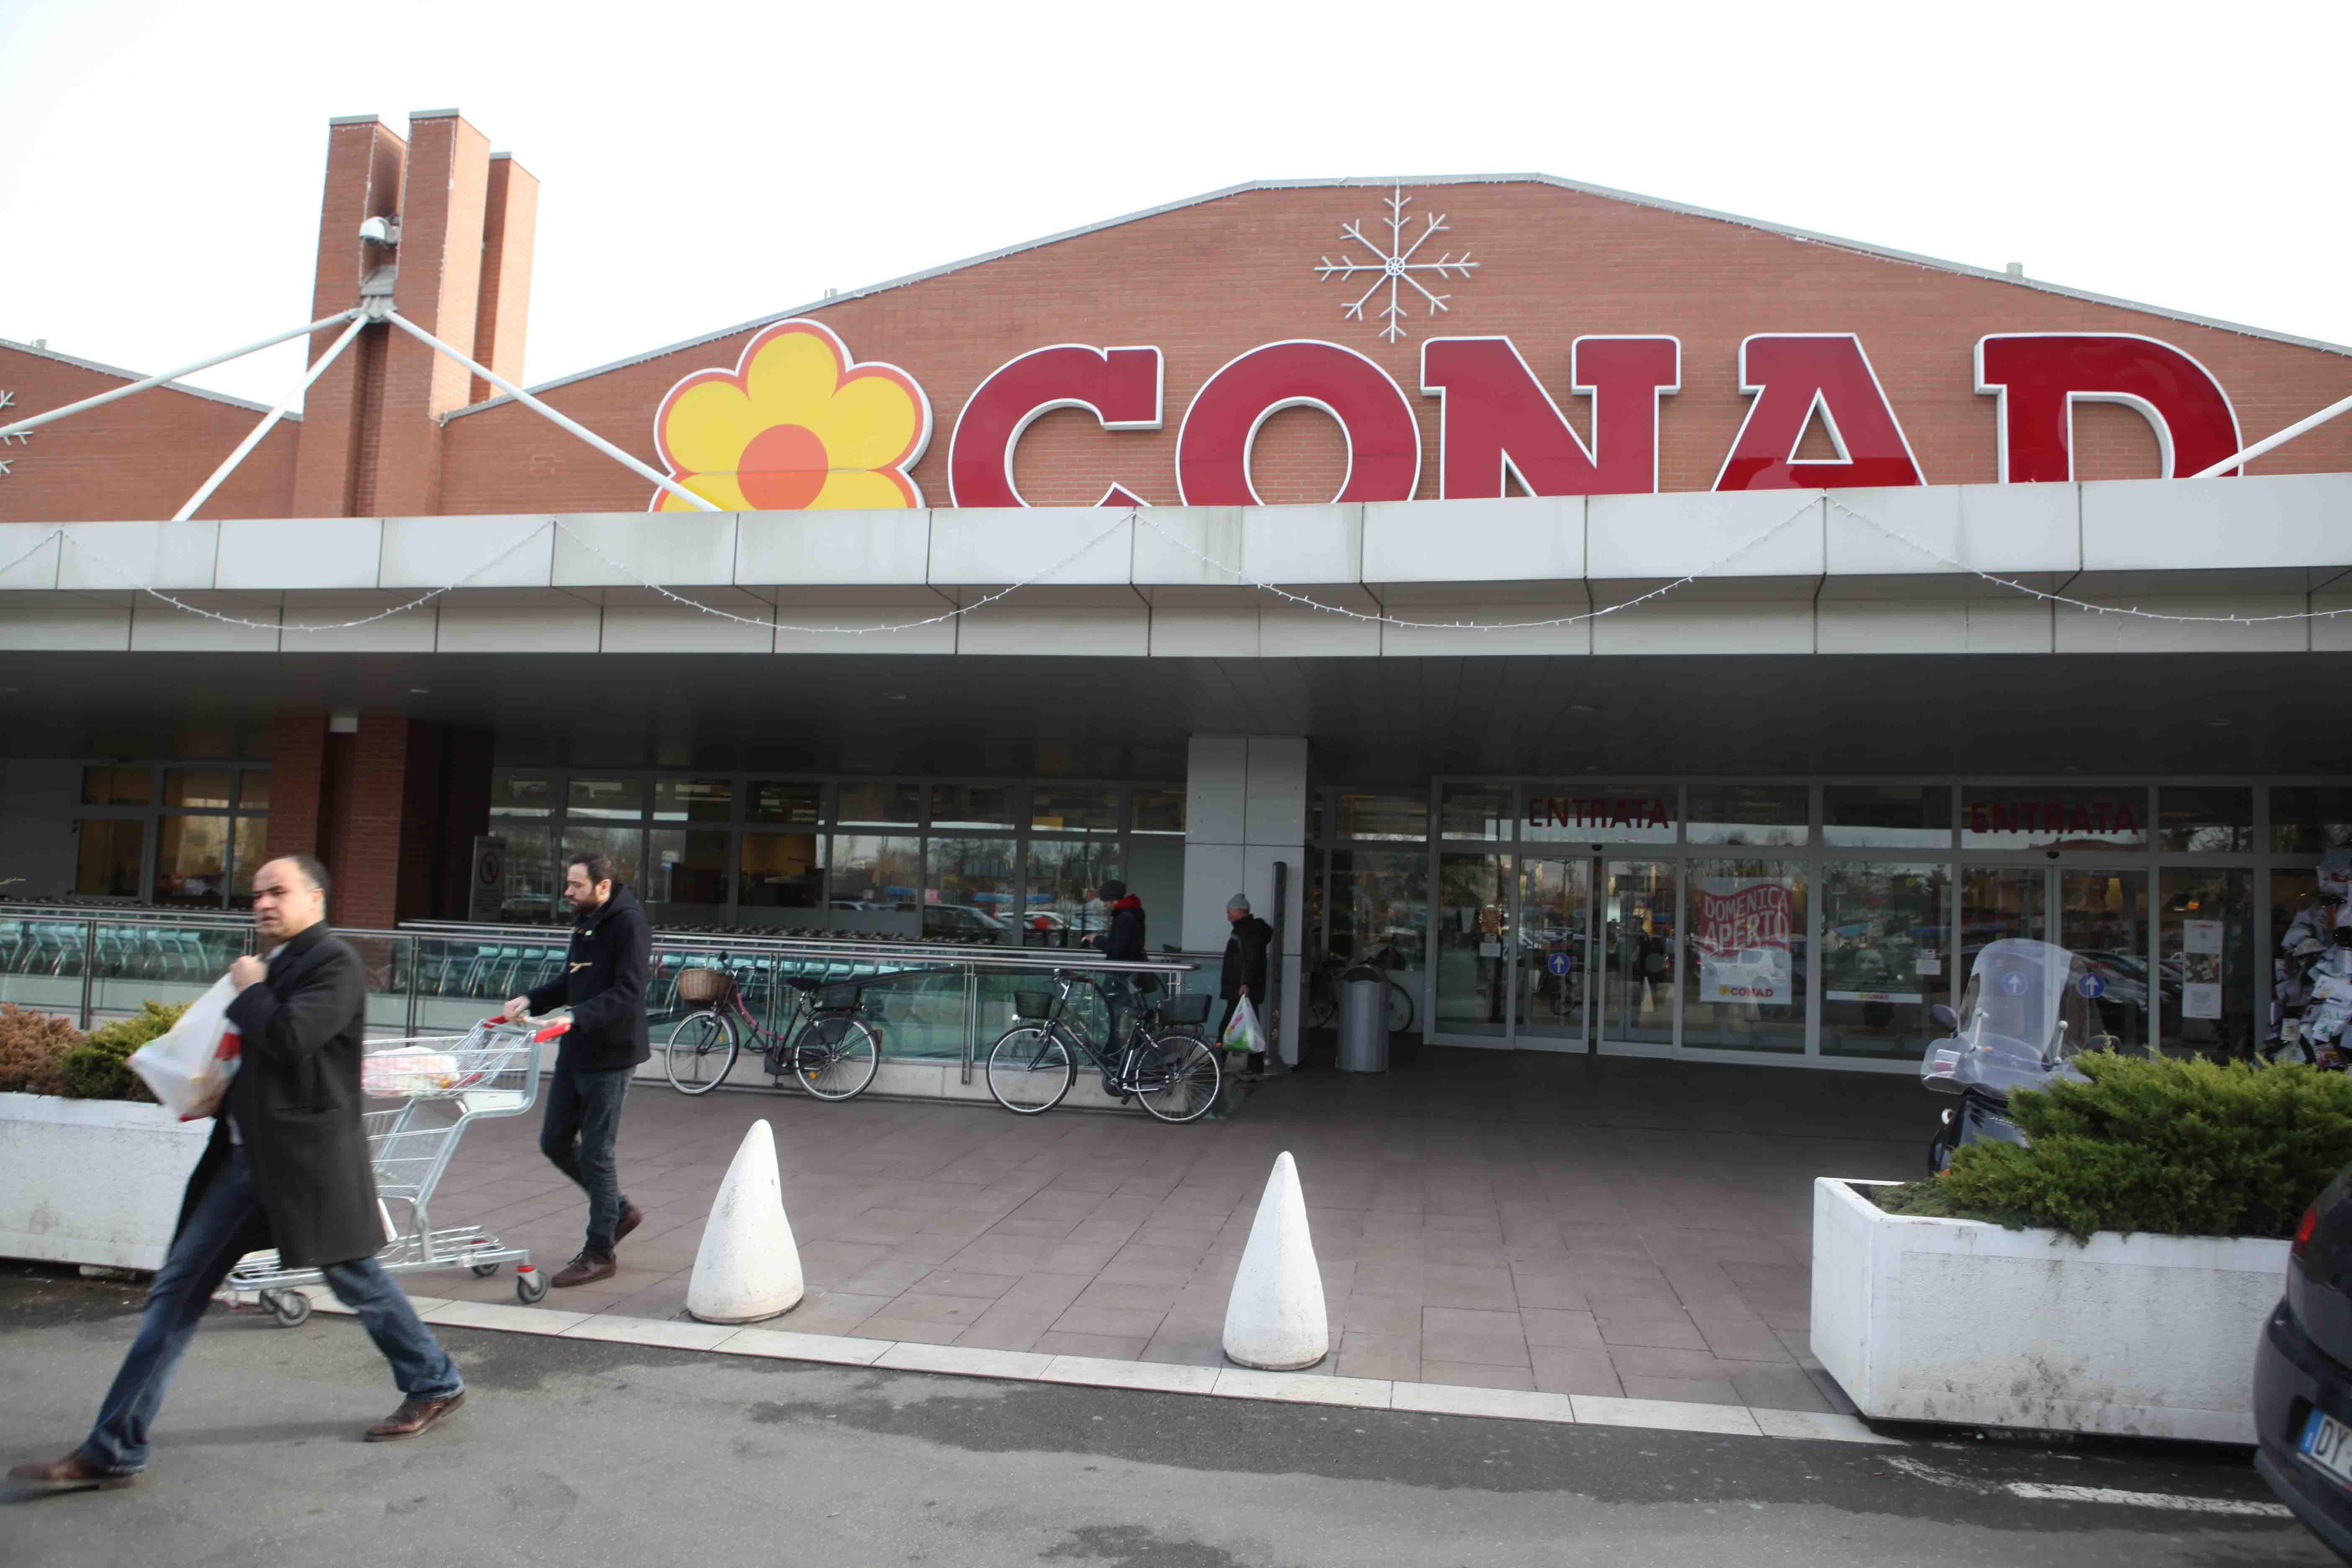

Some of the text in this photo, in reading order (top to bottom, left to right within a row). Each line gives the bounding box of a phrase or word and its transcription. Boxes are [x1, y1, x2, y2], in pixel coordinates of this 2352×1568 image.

[948, 332, 2244, 507] CONAD
[1530, 797, 1669, 828] ENTRATA
[1970, 800, 2138, 834] ENTRATA
[1705, 887, 1789, 922] DOMENICA
[1704, 912, 1790, 953] APERTO
[2315, 1419, 2352, 1474] DY
